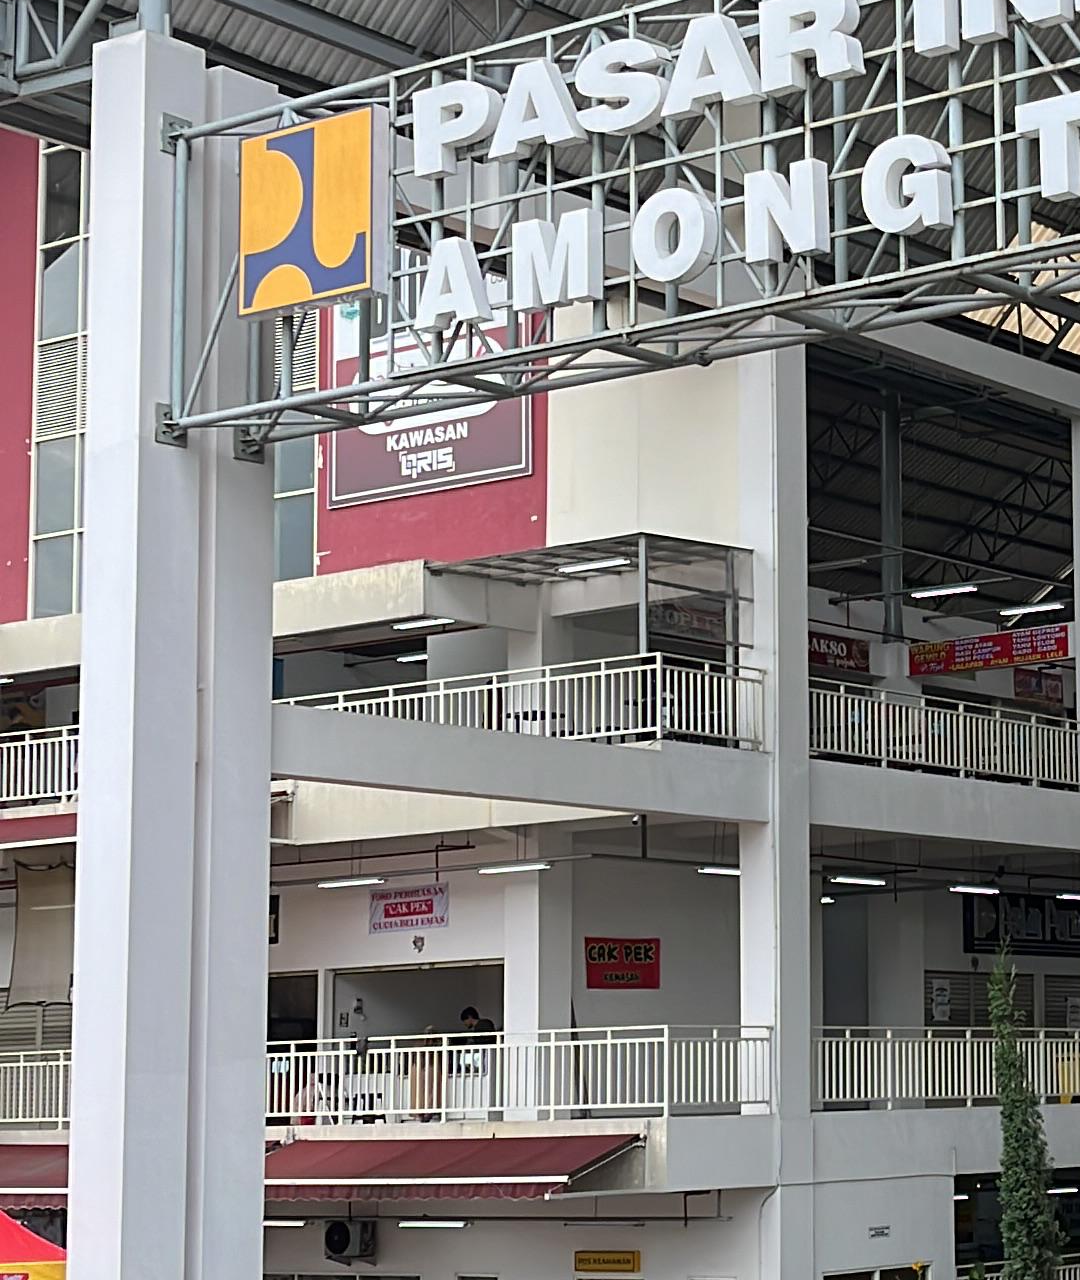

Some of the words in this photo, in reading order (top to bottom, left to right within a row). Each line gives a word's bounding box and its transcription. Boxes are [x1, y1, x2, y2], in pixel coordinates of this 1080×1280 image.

[414, 134, 954, 333] AMONG
[386, 422, 468, 452] KAWASAN
[400, 447, 455, 478] QRIS
[808, 638, 847, 657] AKSO
[911, 641, 952, 655] WARUNG
[587, 943, 619, 964] CAK
[622, 943, 656, 964] PEK
